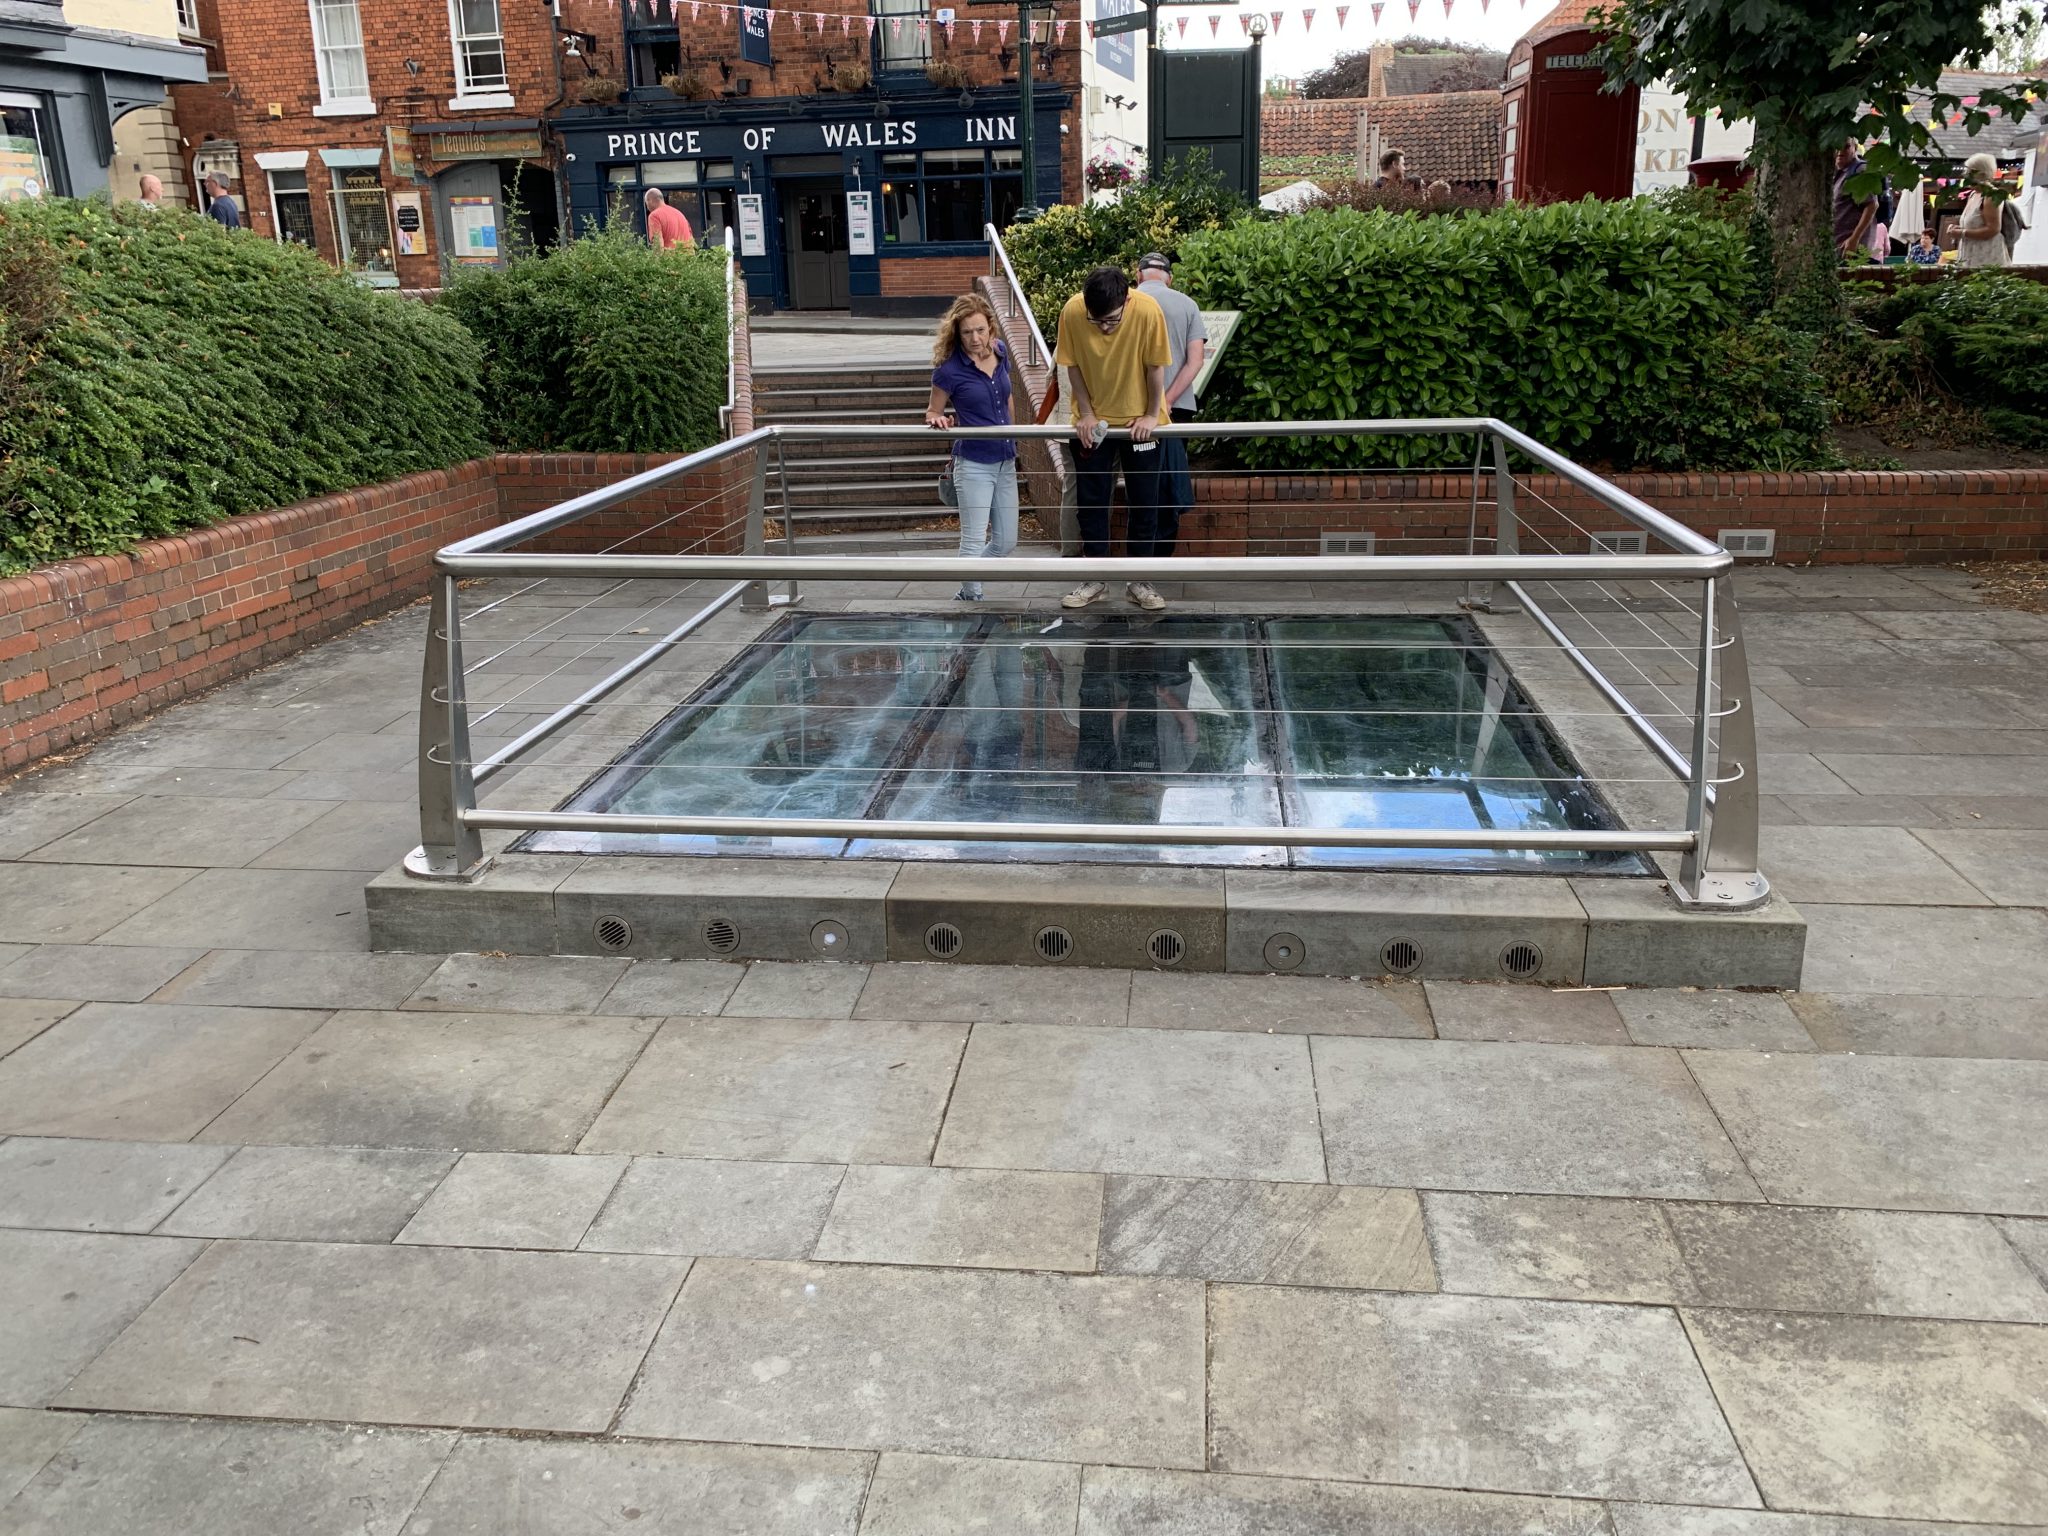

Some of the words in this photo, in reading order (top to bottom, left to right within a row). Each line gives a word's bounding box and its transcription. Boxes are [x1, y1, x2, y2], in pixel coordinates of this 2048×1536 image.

[439, 131, 487, 155] Tequilas
[607, 130, 701, 157] PRINCE
[743, 127, 776, 151] OF
[821, 120, 917, 148] WALES
[965, 116, 1016, 142] INN
[1635, 148, 1690, 173] KE
[1133, 441, 1156, 452] PUMA
